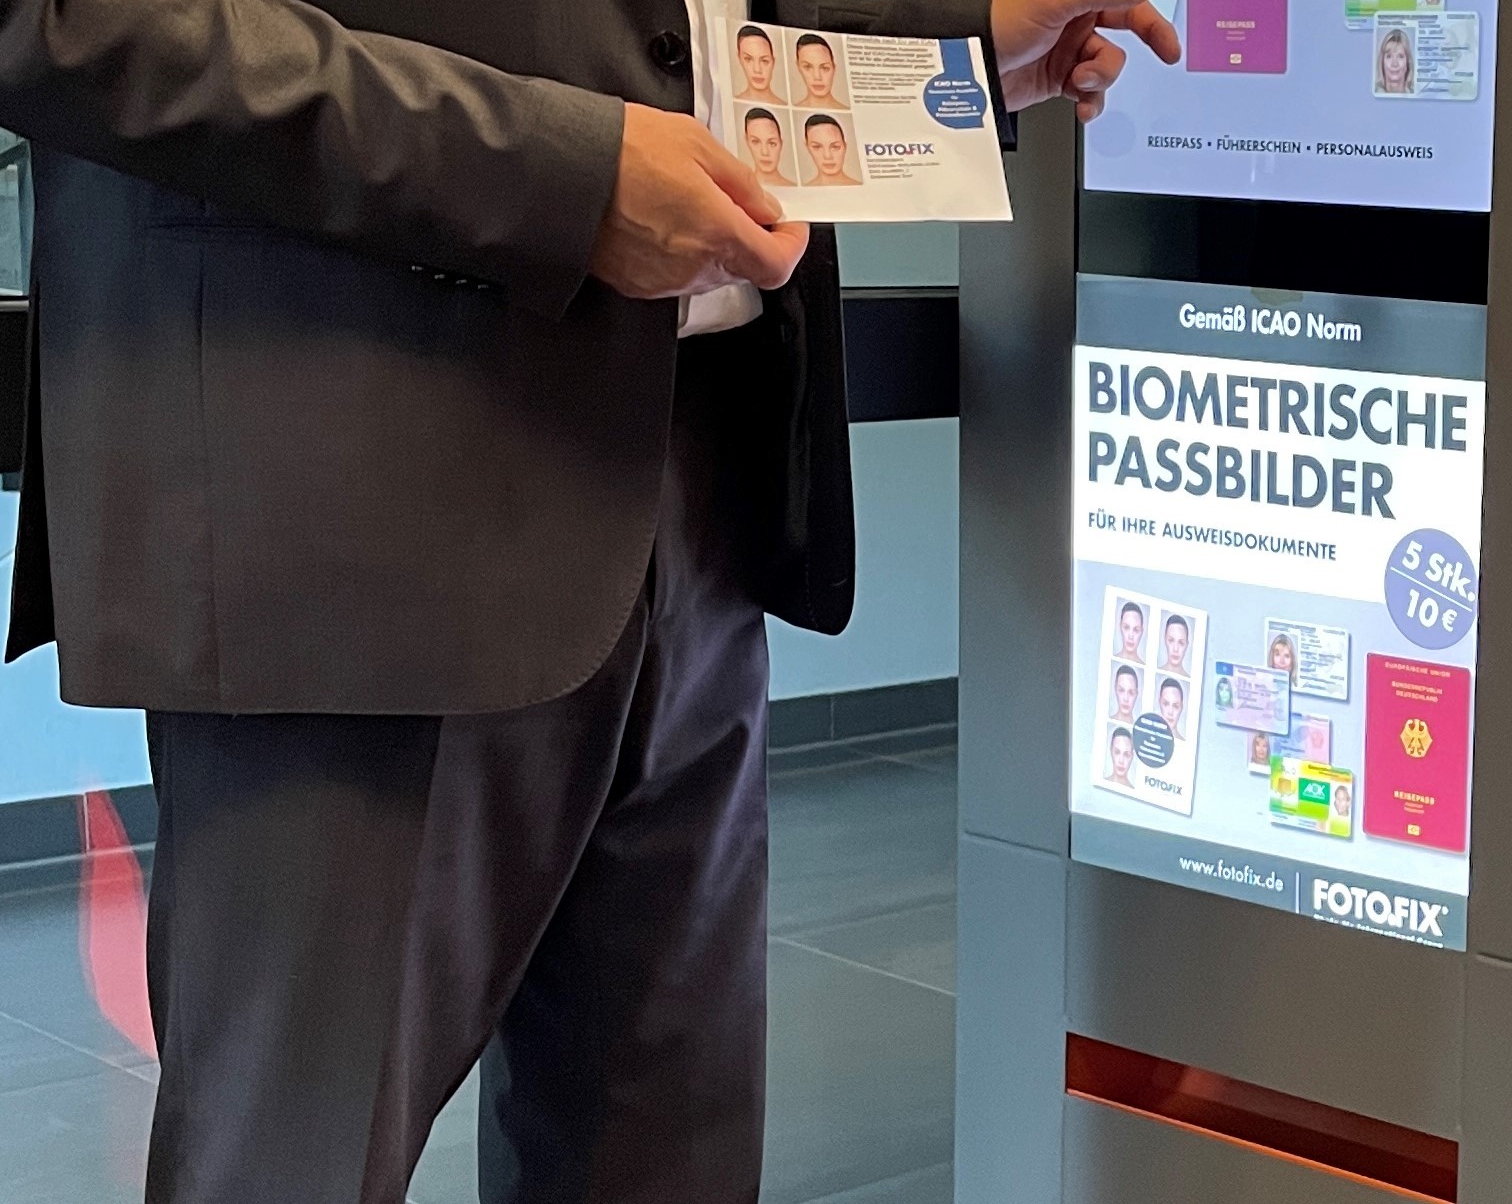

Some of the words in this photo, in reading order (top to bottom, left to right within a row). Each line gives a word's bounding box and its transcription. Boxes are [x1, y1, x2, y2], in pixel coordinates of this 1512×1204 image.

[1147, 135, 1203, 151] REISEPASS
[1217, 134, 1301, 154] FÜHRERSCHEIN
[1316, 143, 1434, 160] PERSONALAUSWEIS
[1179, 303, 1246, 332] Gemäß
[1251, 306, 1301, 337] ICAO
[1306, 313, 1362, 342] Norm
[1088, 360, 1468, 452] BIOMETRISCHE
[1088, 430, 1397, 520] PASSBILDER
[1088, 508, 1117, 532] FÜR
[1122, 516, 1156, 536] IHRE
[1162, 522, 1337, 561] AUSWEISDOKUMENTE
[1402, 540, 1423, 568] 5
[1425, 552, 1477, 602] Stk.
[1179, 856, 1285, 892] www.fotofix.de
